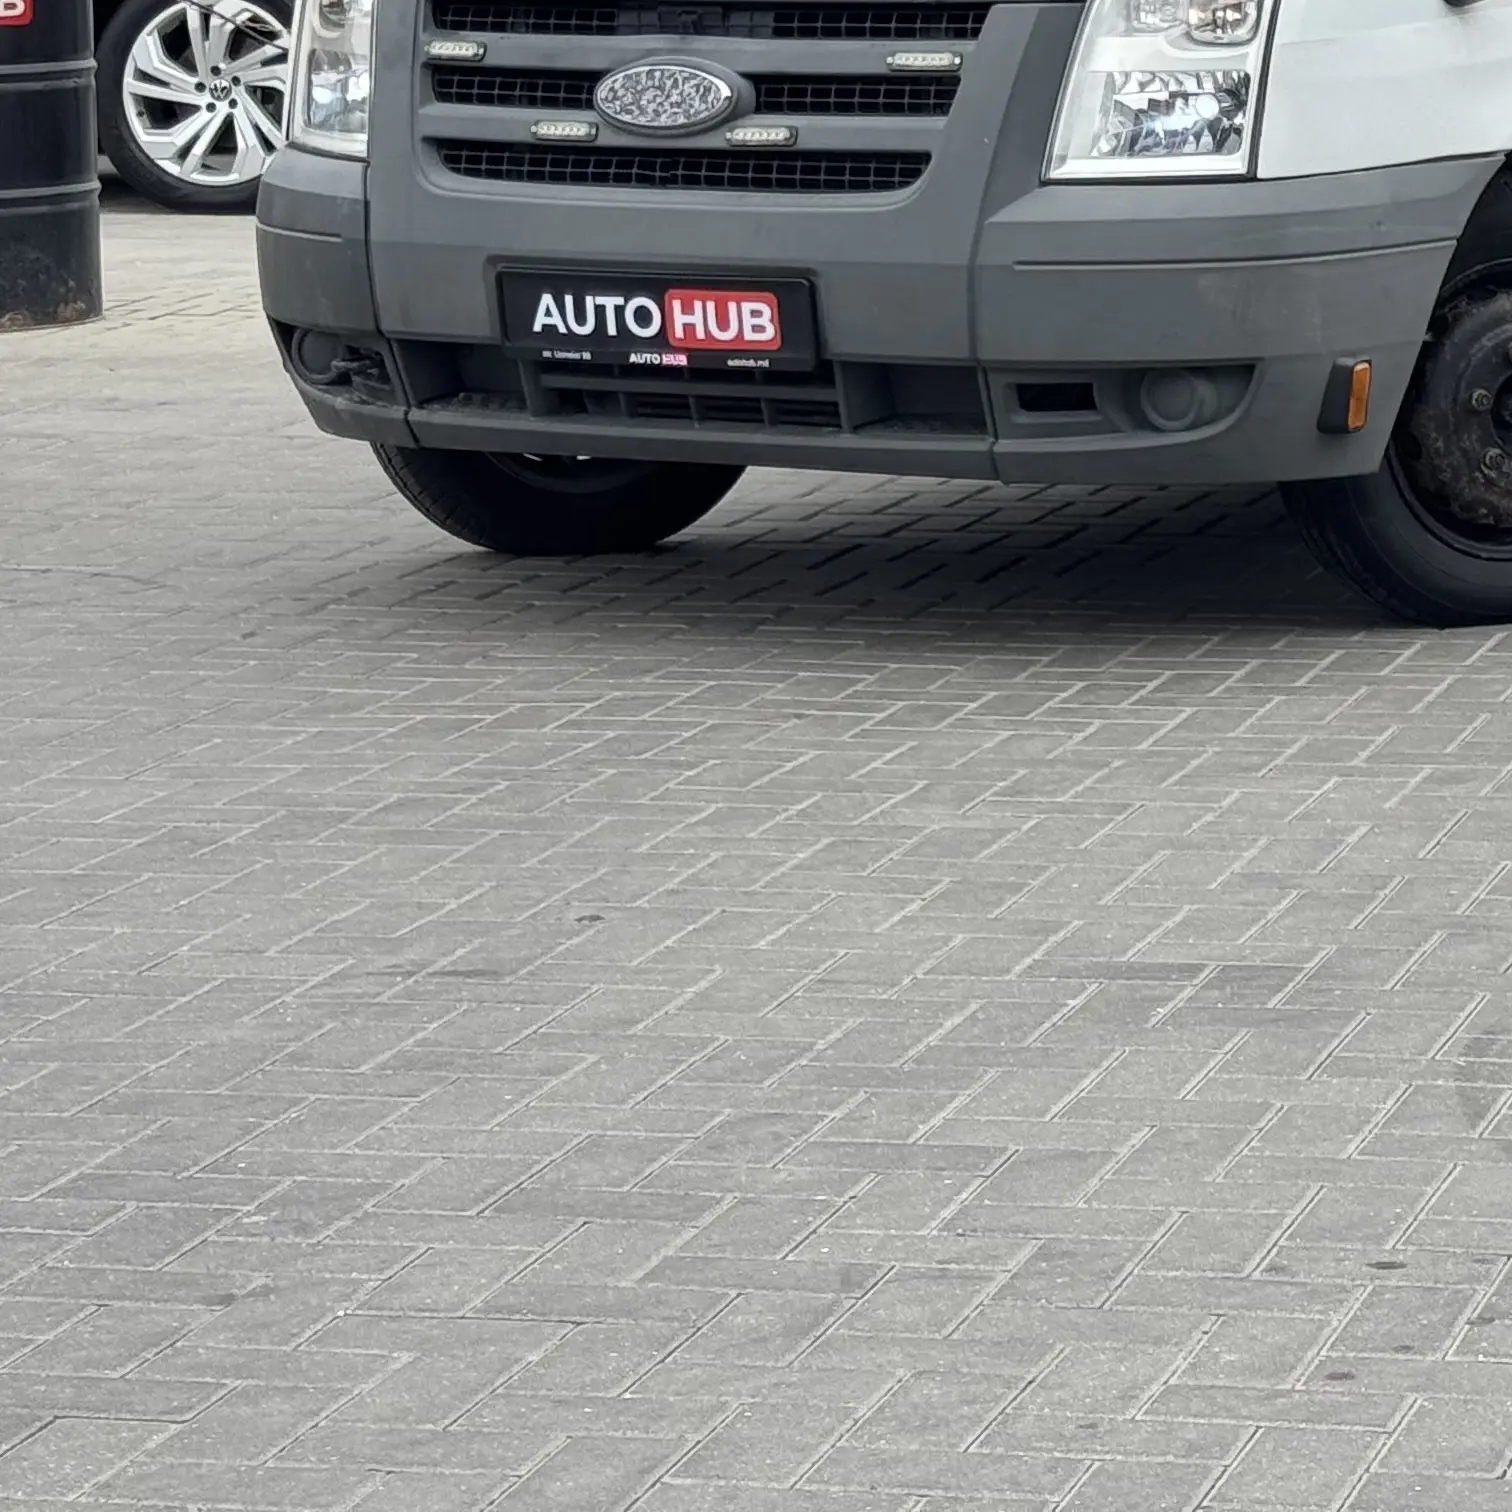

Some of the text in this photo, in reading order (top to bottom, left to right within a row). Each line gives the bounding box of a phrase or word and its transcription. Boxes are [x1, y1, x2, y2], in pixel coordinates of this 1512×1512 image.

[532, 293, 777, 341] AUTO HUB
[629, 353, 660, 365] AUTO
